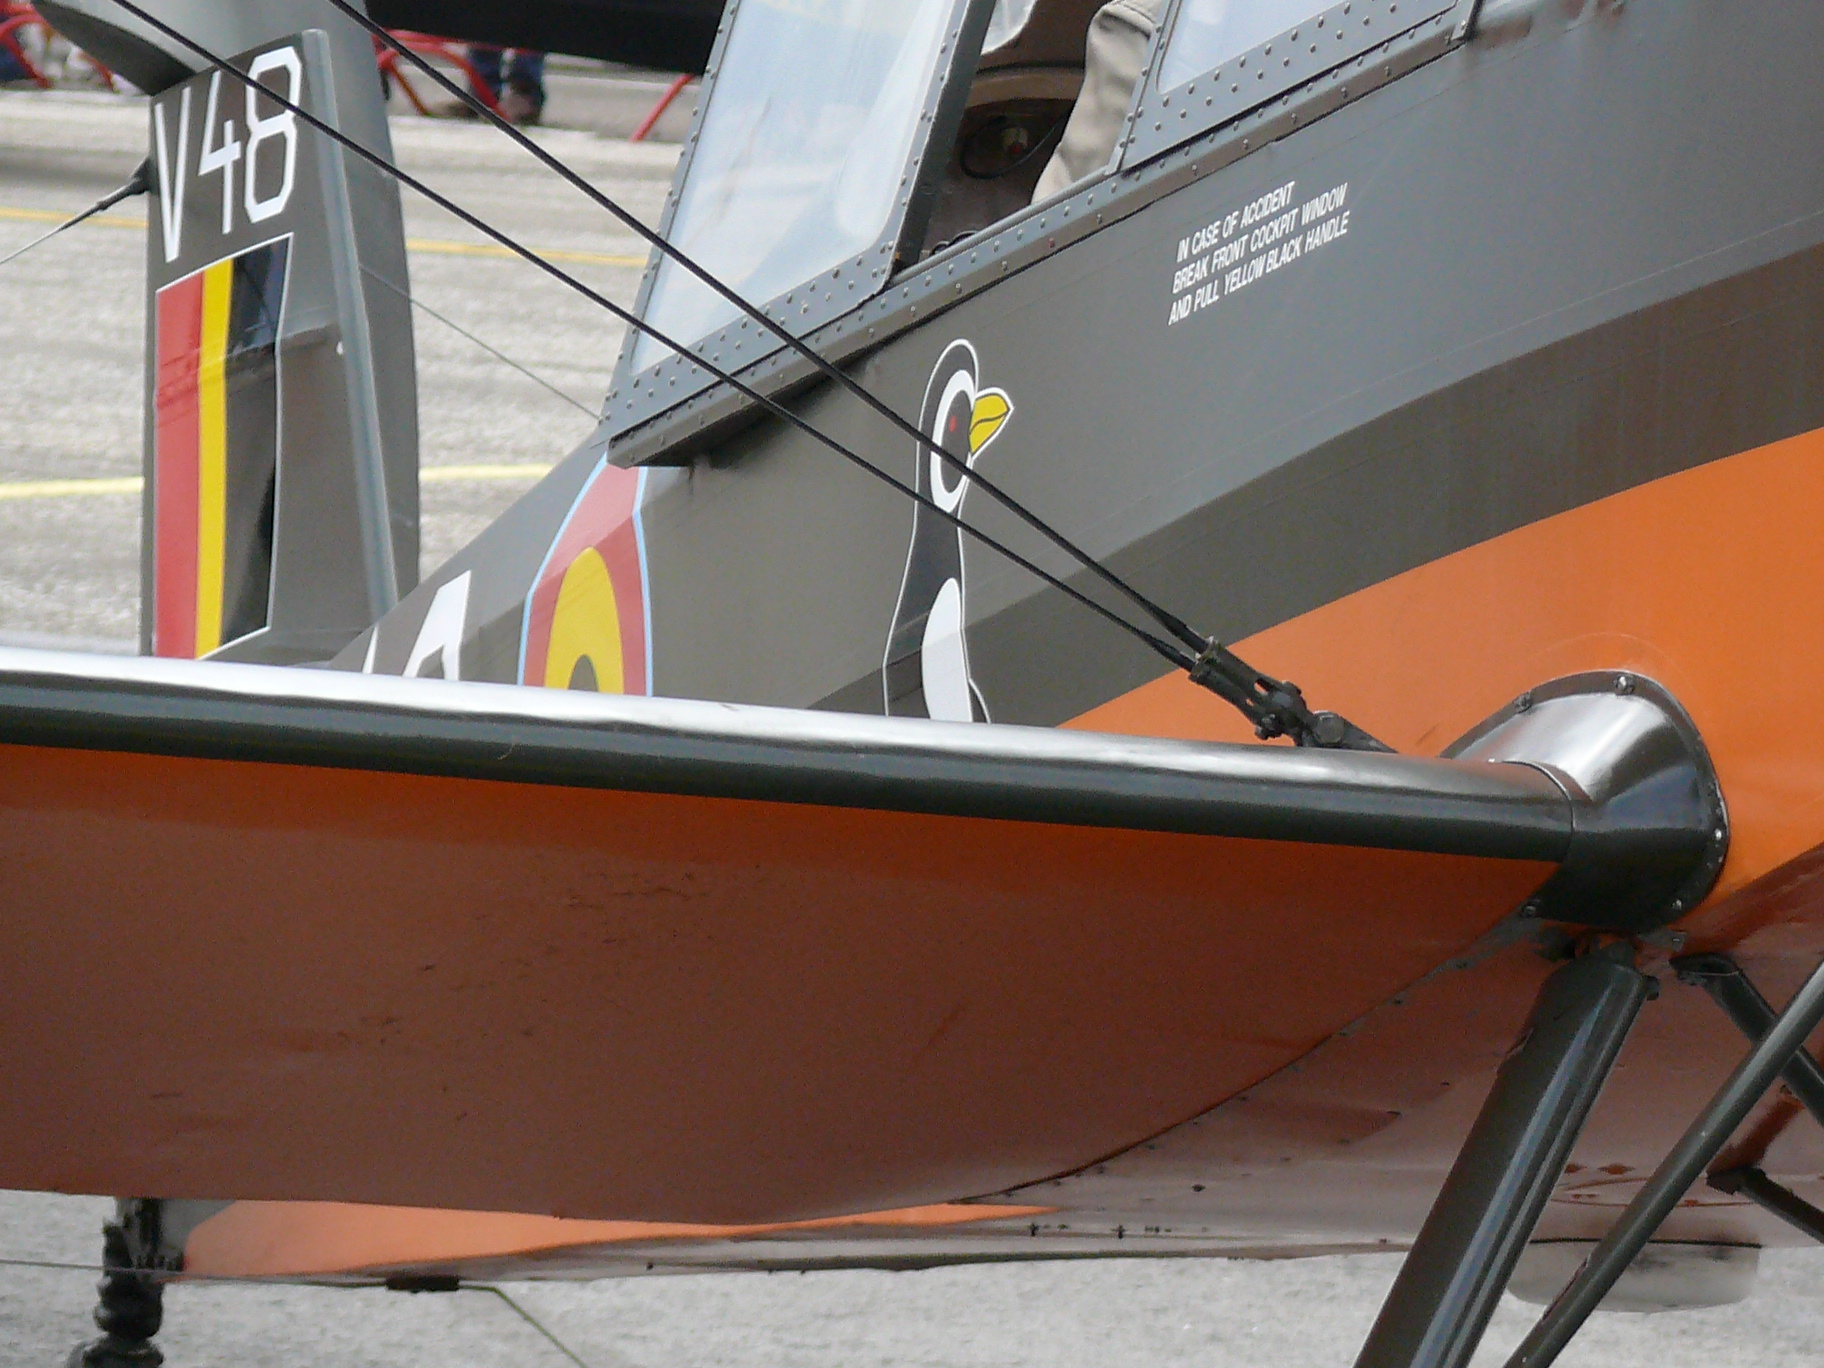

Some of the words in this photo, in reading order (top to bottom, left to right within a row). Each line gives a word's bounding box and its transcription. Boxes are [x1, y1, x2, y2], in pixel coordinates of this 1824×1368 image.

[154, 45, 302, 263] V48
[1168, 294, 1192, 326] AND
[1193, 279, 1219, 312] PULL
[1224, 255, 1267, 296] YELLOW
[1265, 234, 1303, 273] BLACK
[1304, 210, 1351, 253] HANDLE
[1172, 260, 1208, 294] BREAK
[1211, 235, 1250, 273] FRONT
[1250, 208, 1299, 252] COCKPIT
[1301, 182, 1349, 226] WINDOW
[1176, 237, 1190, 263] IN
[1192, 220, 1221, 255] CASE
[1222, 211, 1240, 238] OF
[1240, 181, 1296, 229] ACCIDENT
